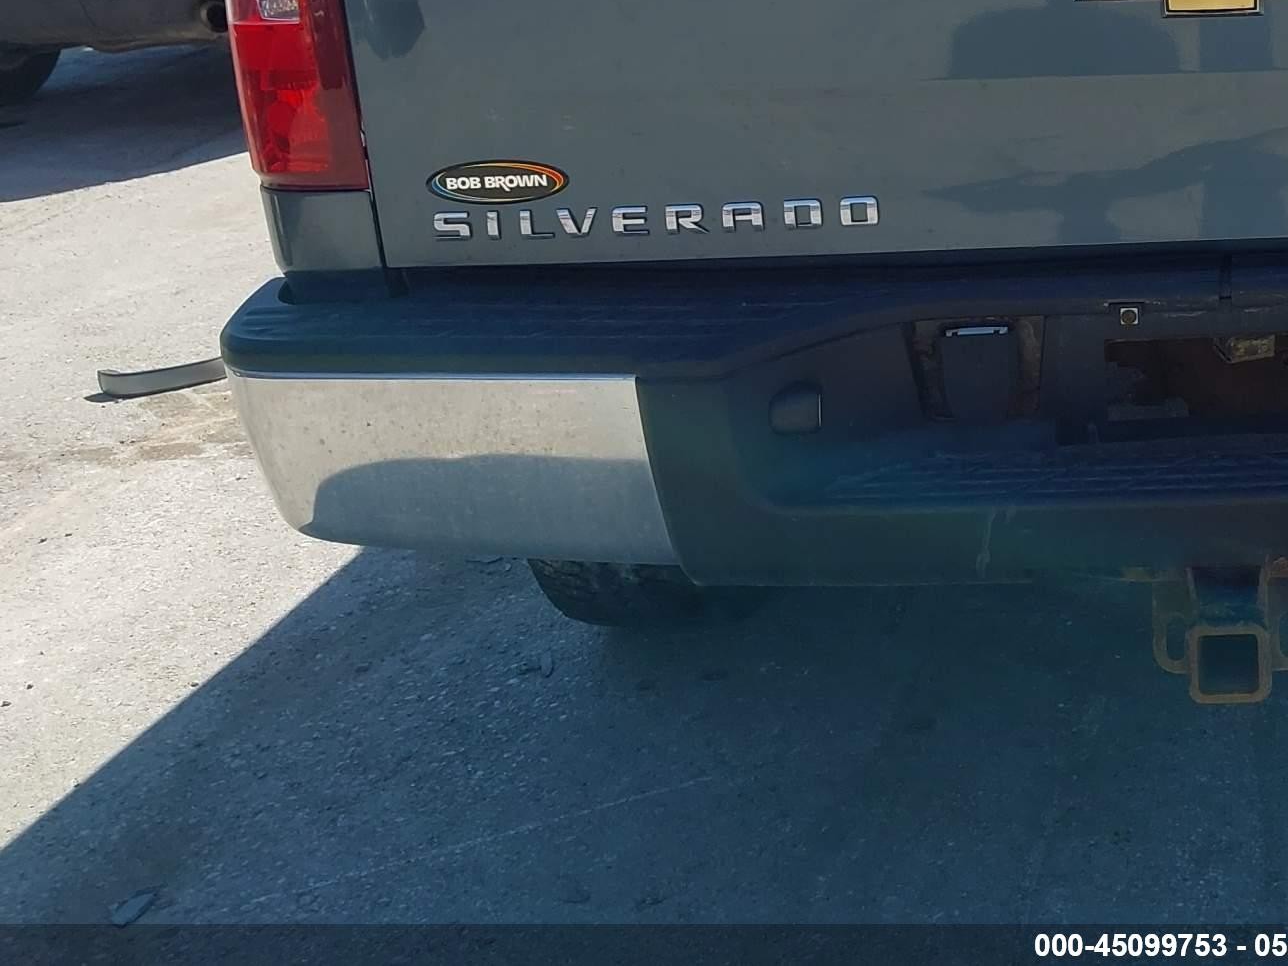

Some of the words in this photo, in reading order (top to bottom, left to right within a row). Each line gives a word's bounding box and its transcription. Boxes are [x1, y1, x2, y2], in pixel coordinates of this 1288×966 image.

[445, 177, 481, 190] BOB
[484, 174, 548, 192] BROWN
[432, 195, 882, 241] SILVERADO
